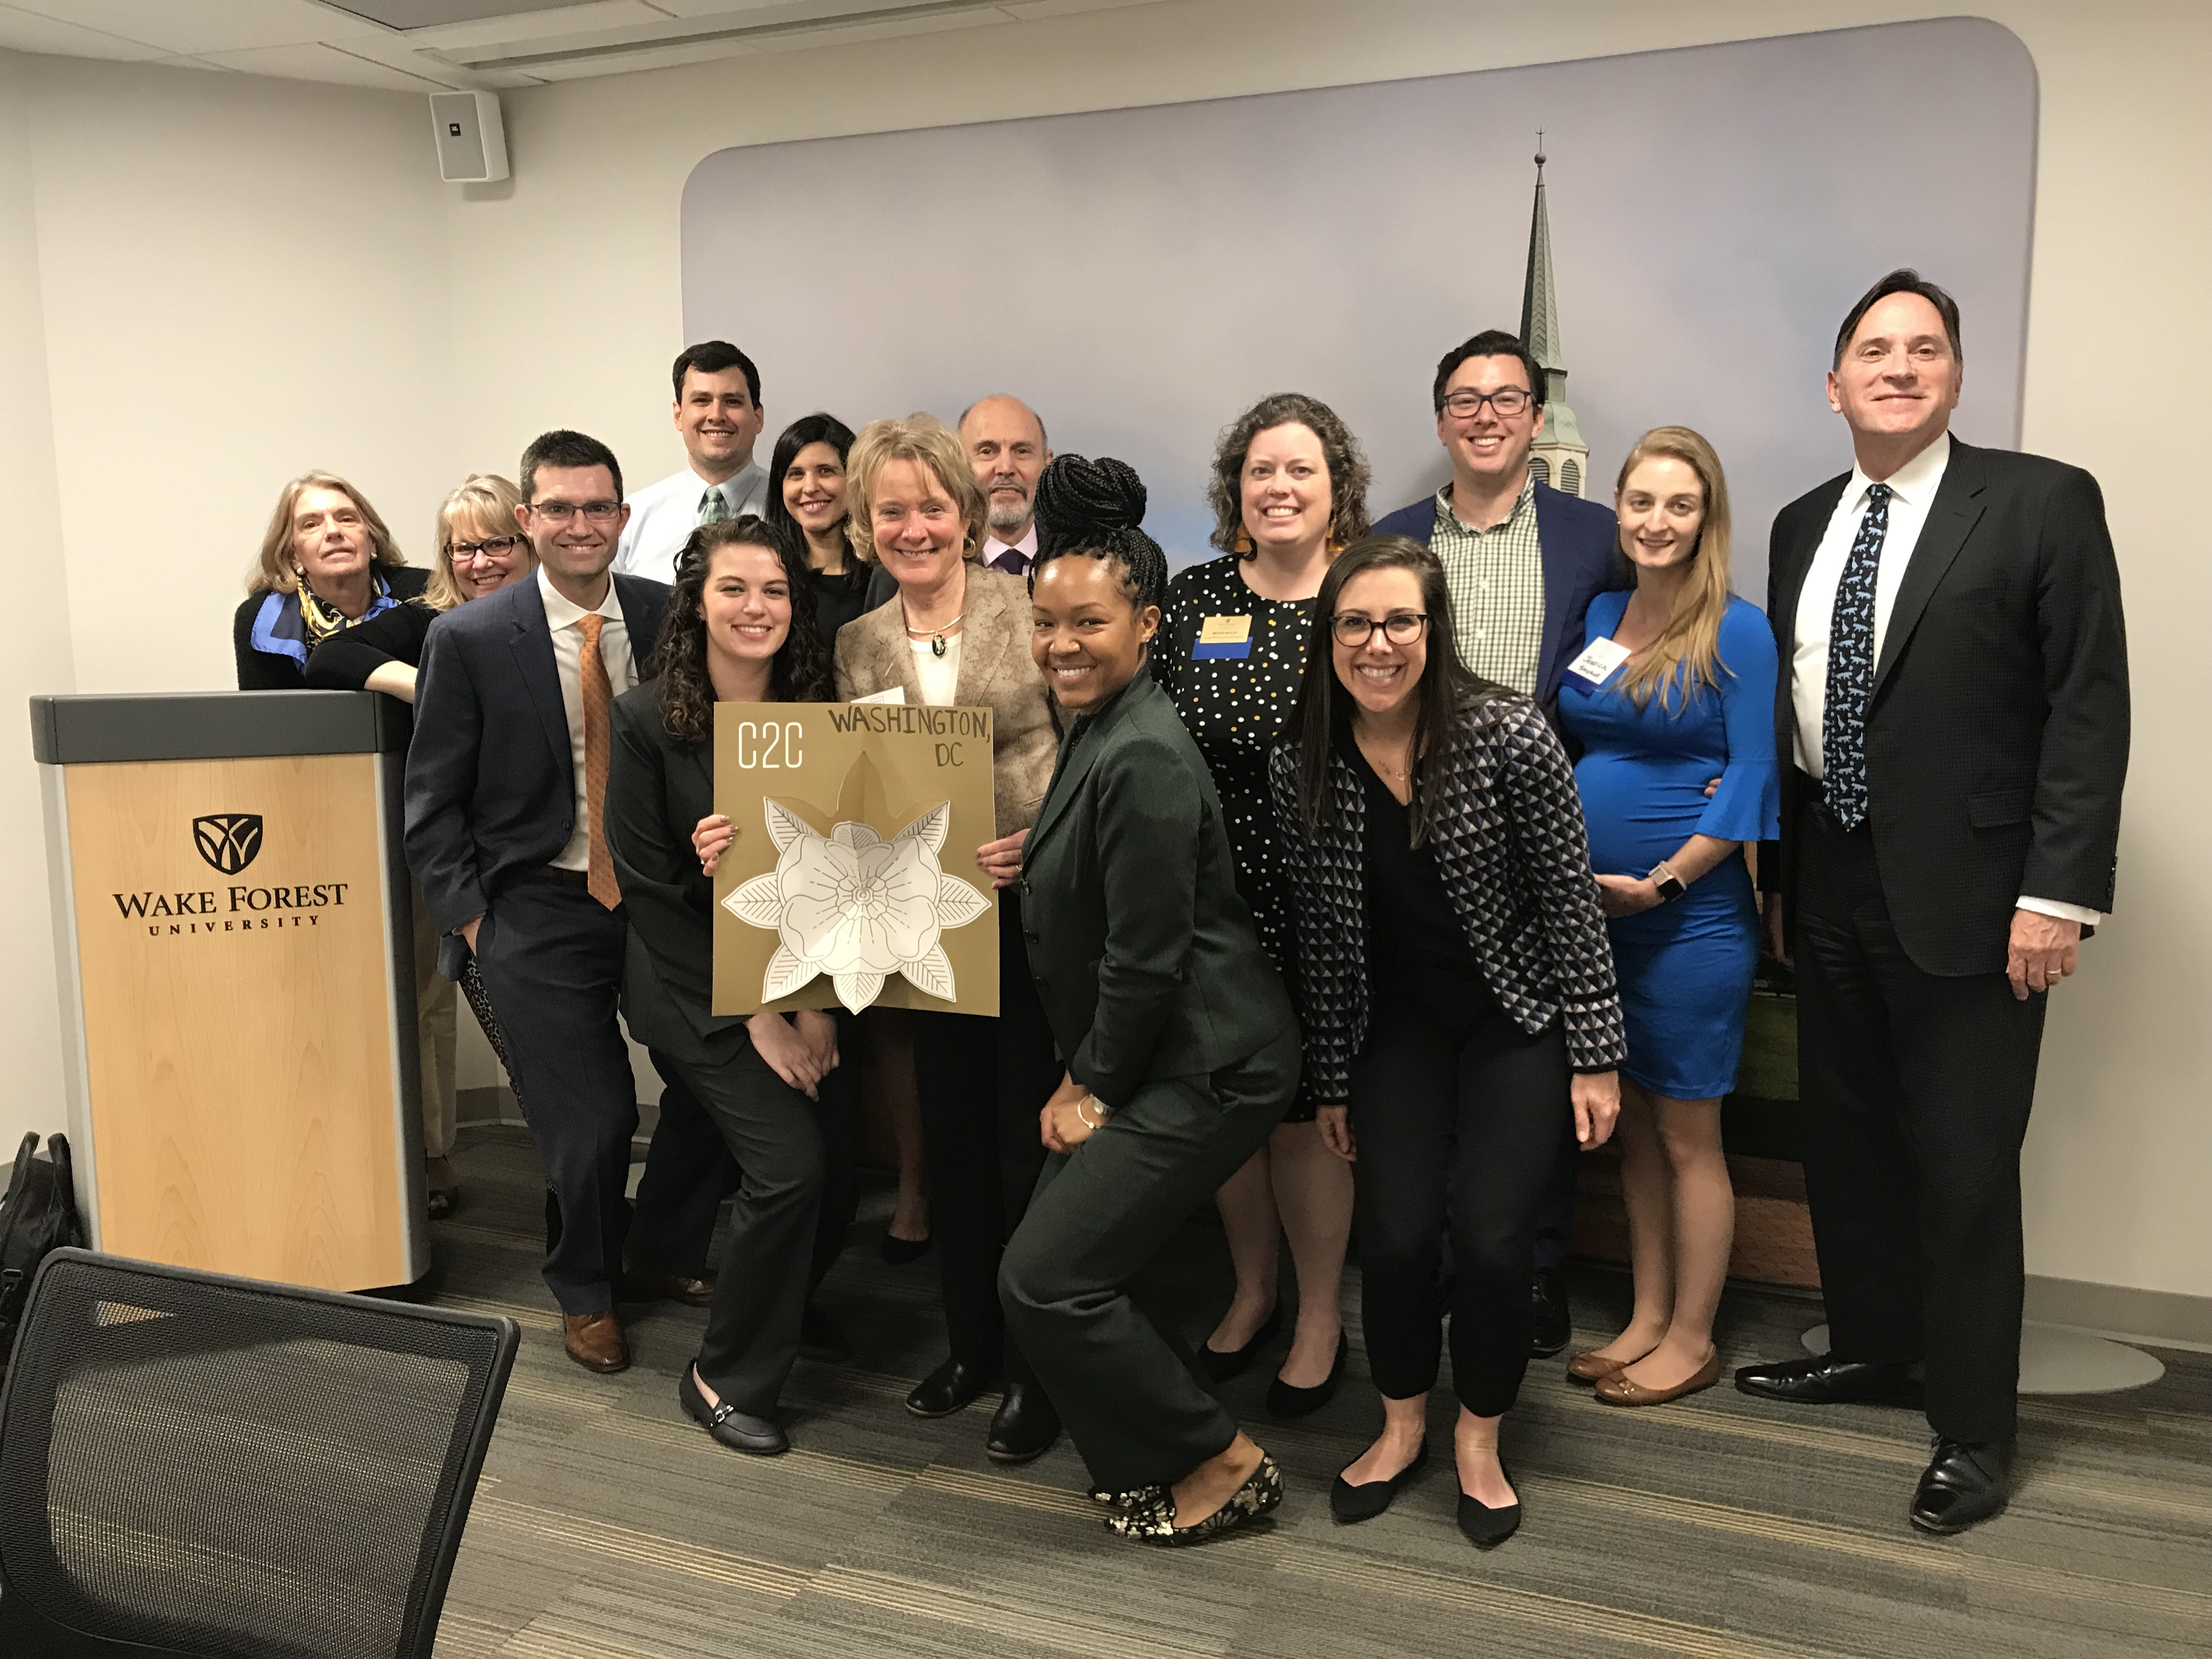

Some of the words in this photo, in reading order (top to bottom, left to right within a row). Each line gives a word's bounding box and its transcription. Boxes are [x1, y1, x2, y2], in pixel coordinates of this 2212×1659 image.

[828, 706, 990, 743] WASHINGTON,
[738, 722, 803, 769] C2C
[935, 742, 964, 767] DC
[112, 891, 217, 919] WAKE
[227, 883, 348, 912] FOREST
[149, 915, 319, 936] UNIVERSITY
